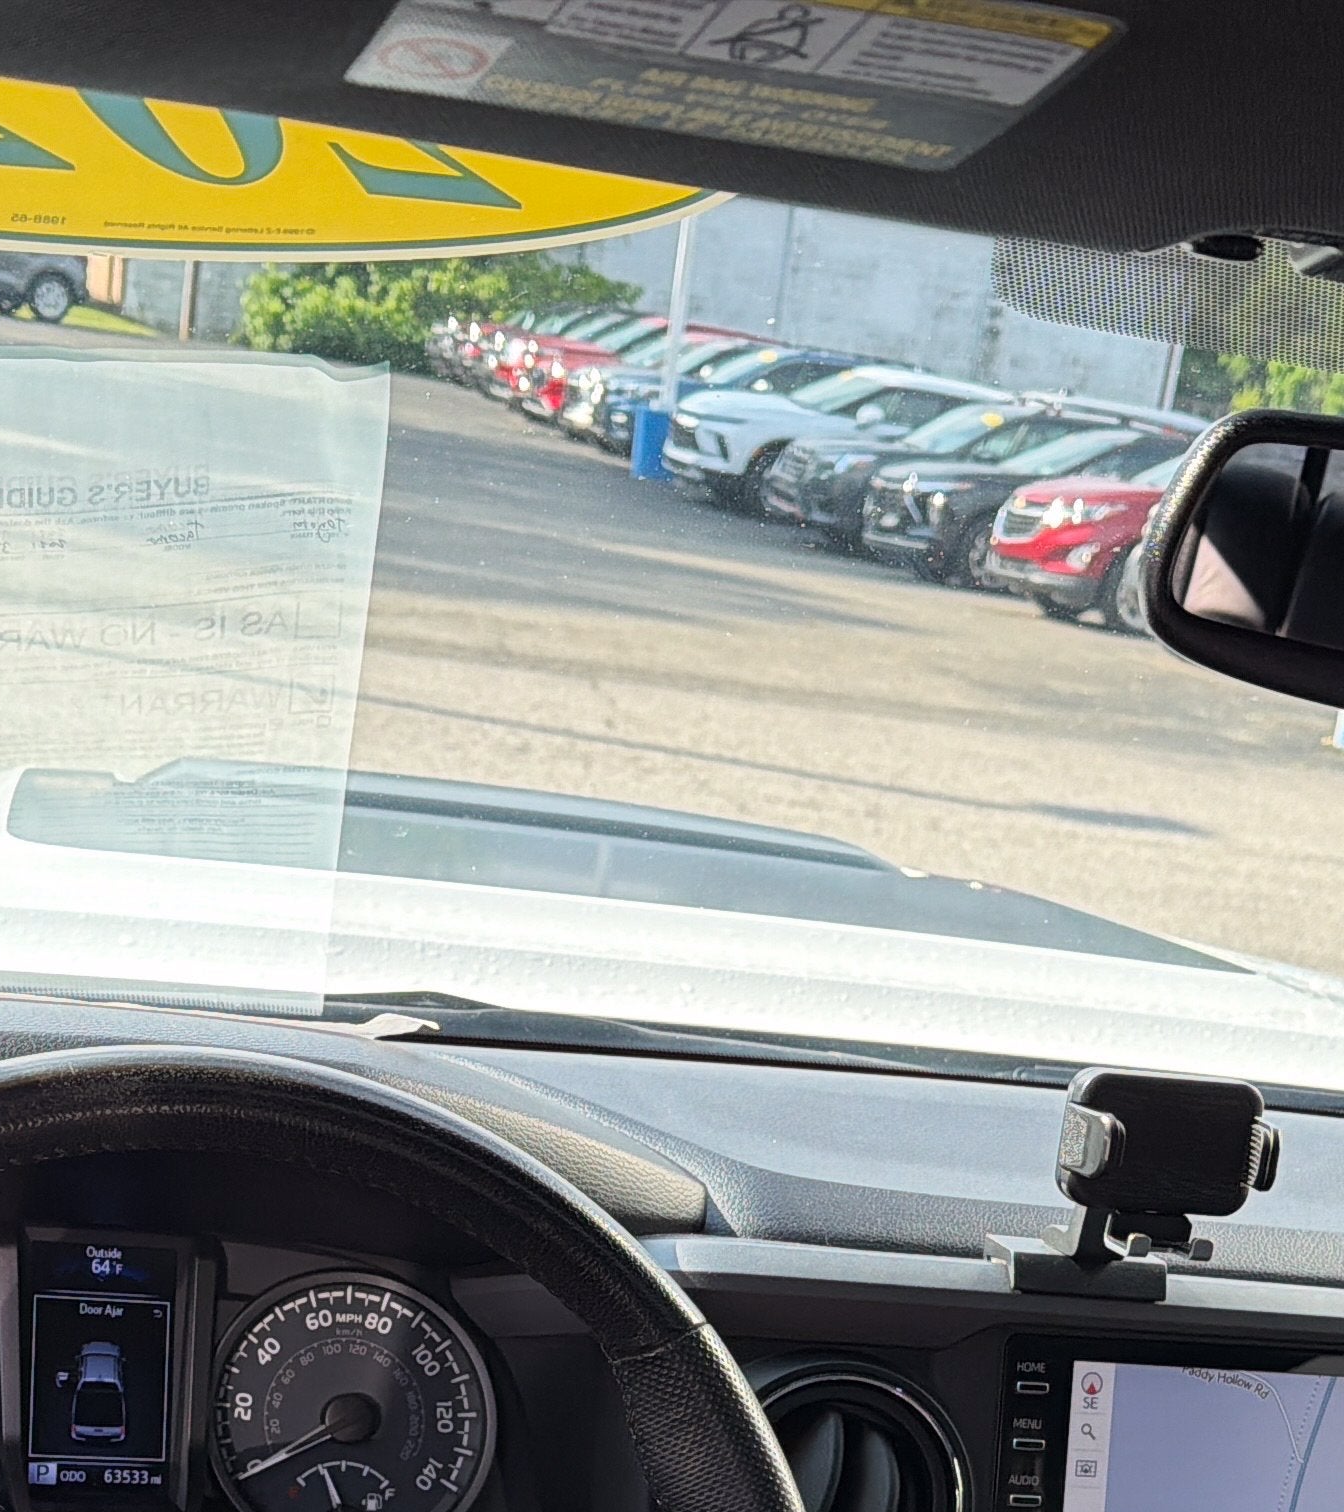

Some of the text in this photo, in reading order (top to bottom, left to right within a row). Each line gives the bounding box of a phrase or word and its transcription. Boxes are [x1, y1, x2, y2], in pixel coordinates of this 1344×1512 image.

[86, 1245, 123, 1260] Outside
[79, 1302, 125, 1318] Door Ajar
[306, 1309, 333, 1331] 60
[335, 1313, 363, 1324] MPH
[364, 1312, 393, 1334] 80
[256, 1337, 281, 1366] 40
[322, 1343, 342, 1355] 100
[348, 1343, 368, 1356] 120
[299, 1352, 316, 1367] 80
[372, 1352, 392, 1368] 140
[411, 1343, 441, 1377] 100
[1016, 1361, 1047, 1374] HOME
[281, 1369, 296, 1385] 60
[1217, 1371, 1270, 1400] Hollow Rd
[233, 1392, 254, 1421] 20
[273, 1392, 284, 1409] 40
[1082, 1396, 1098, 1410] SE
[436, 1400, 454, 1434] 120
[1012, 1417, 1043, 1430] MENU
[270, 1418, 281, 1435] 20
[36, 1463, 50, 1482] P
[60, 1469, 162, 1485] ODO 63533 mi
[415, 1457, 444, 1491] 140
[1008, 1474, 1040, 1486] AUDIO
